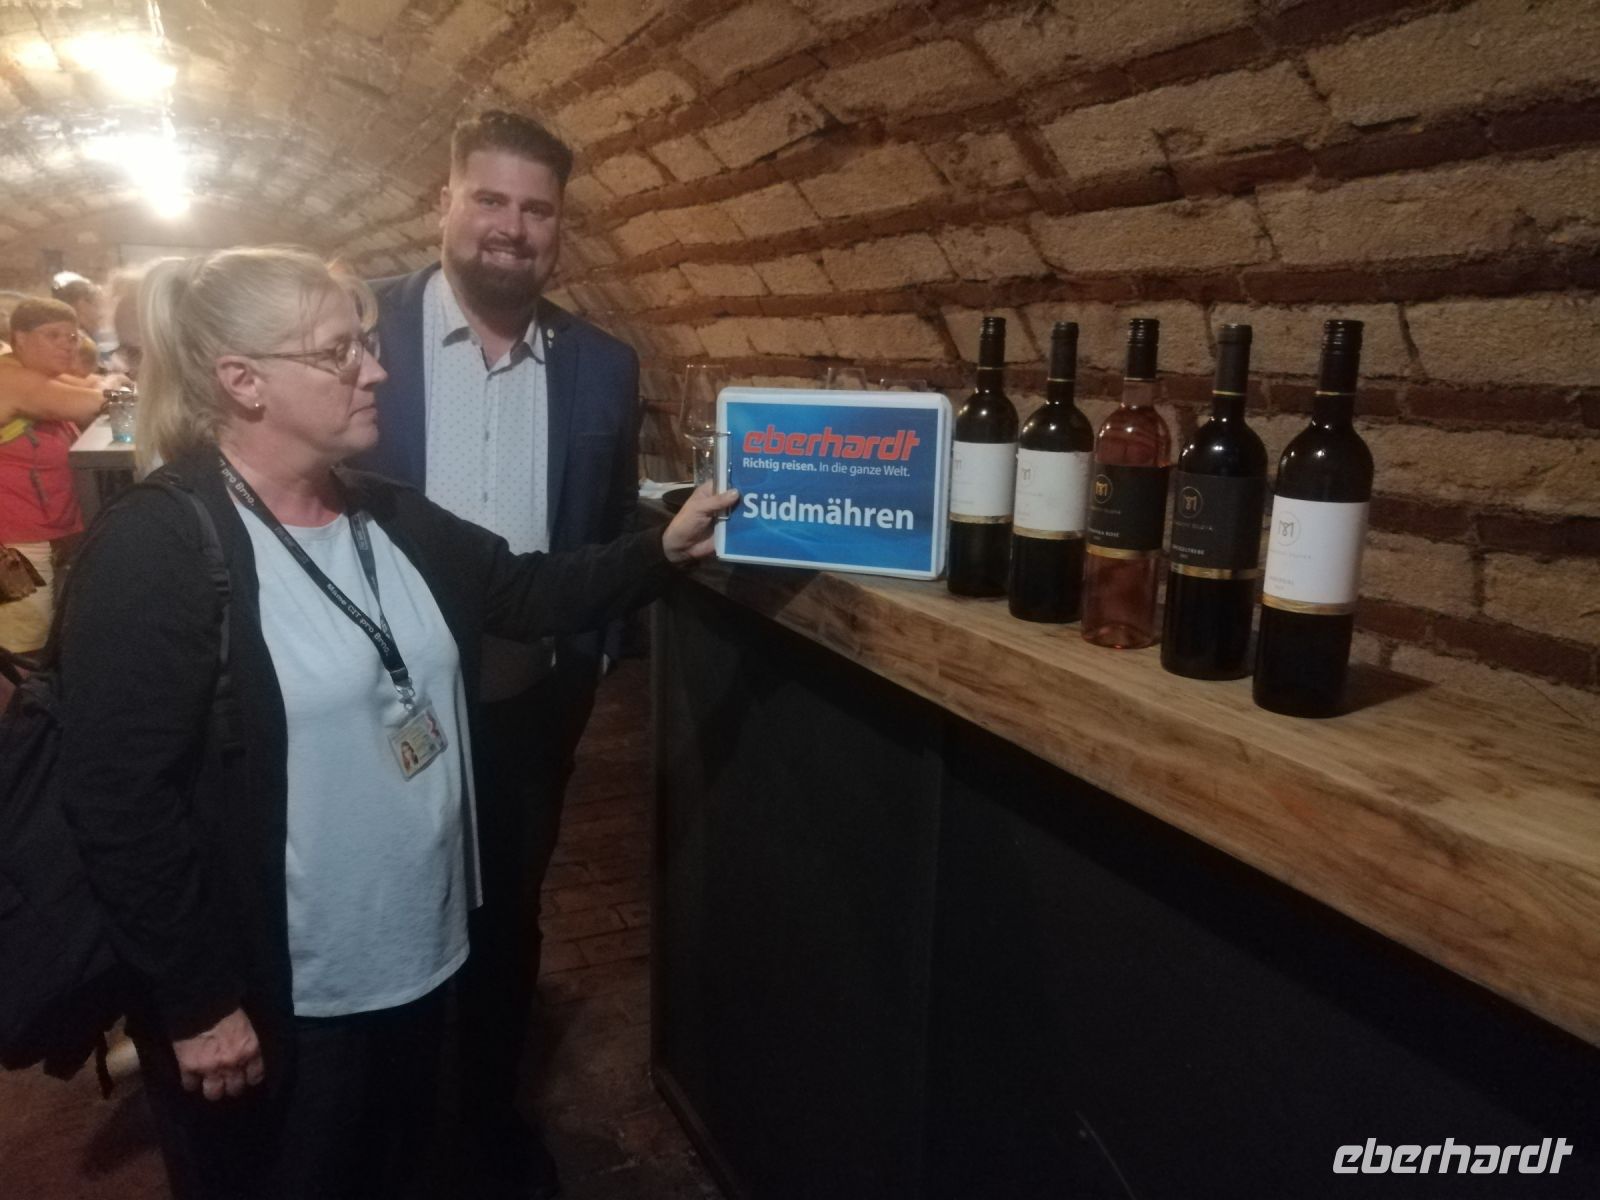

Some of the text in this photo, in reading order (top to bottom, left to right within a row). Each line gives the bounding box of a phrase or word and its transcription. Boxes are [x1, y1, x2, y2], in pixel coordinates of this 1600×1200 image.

[743, 424, 920, 461] eberhardt
[743, 457, 910, 477] Richtig reisen. In die ganze Welt.
[743, 492, 914, 530] Südmähren
